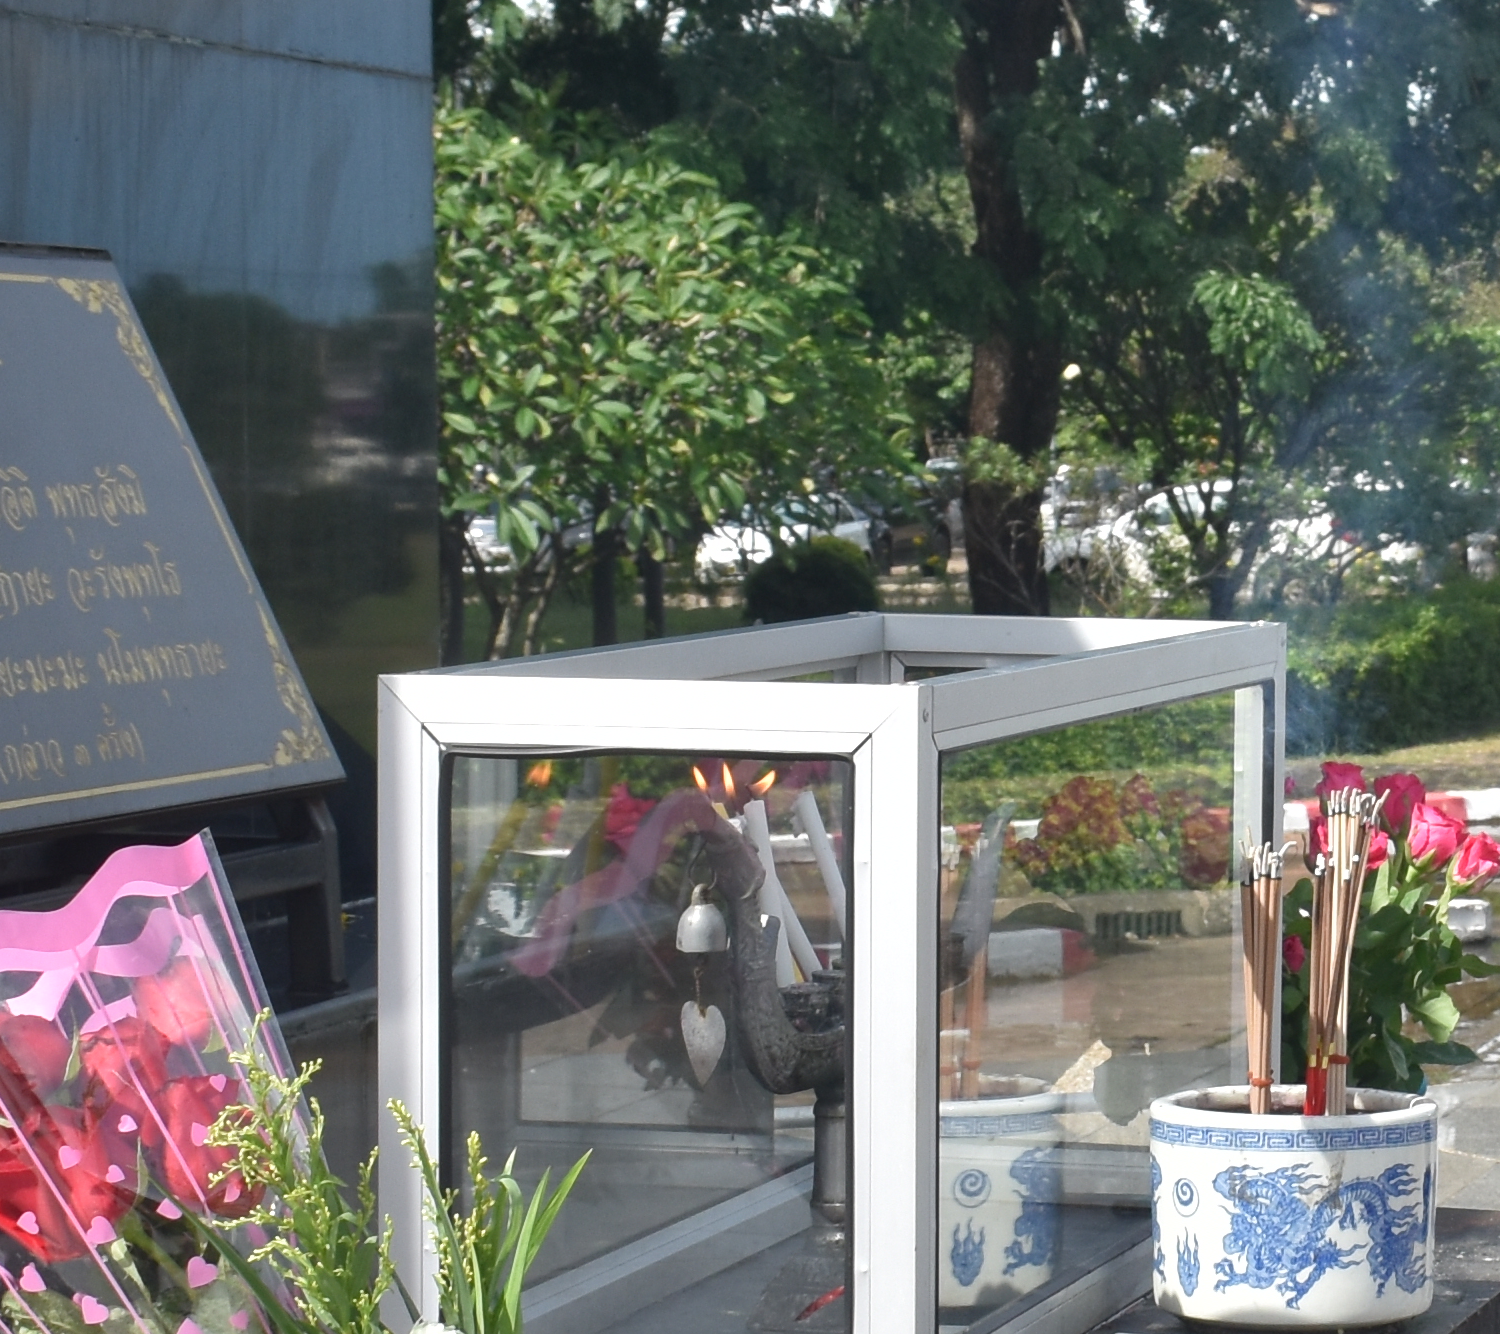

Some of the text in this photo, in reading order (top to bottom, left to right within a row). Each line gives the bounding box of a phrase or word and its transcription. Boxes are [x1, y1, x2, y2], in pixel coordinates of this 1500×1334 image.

[45, 464, 148, 546] พุทธสังมิ
[67, 541, 183, 622] วะรังพุทโธ
[97, 628, 228, 708] นโมพุทธายะ
[96, 702, 147, 766] ครั้ง)
